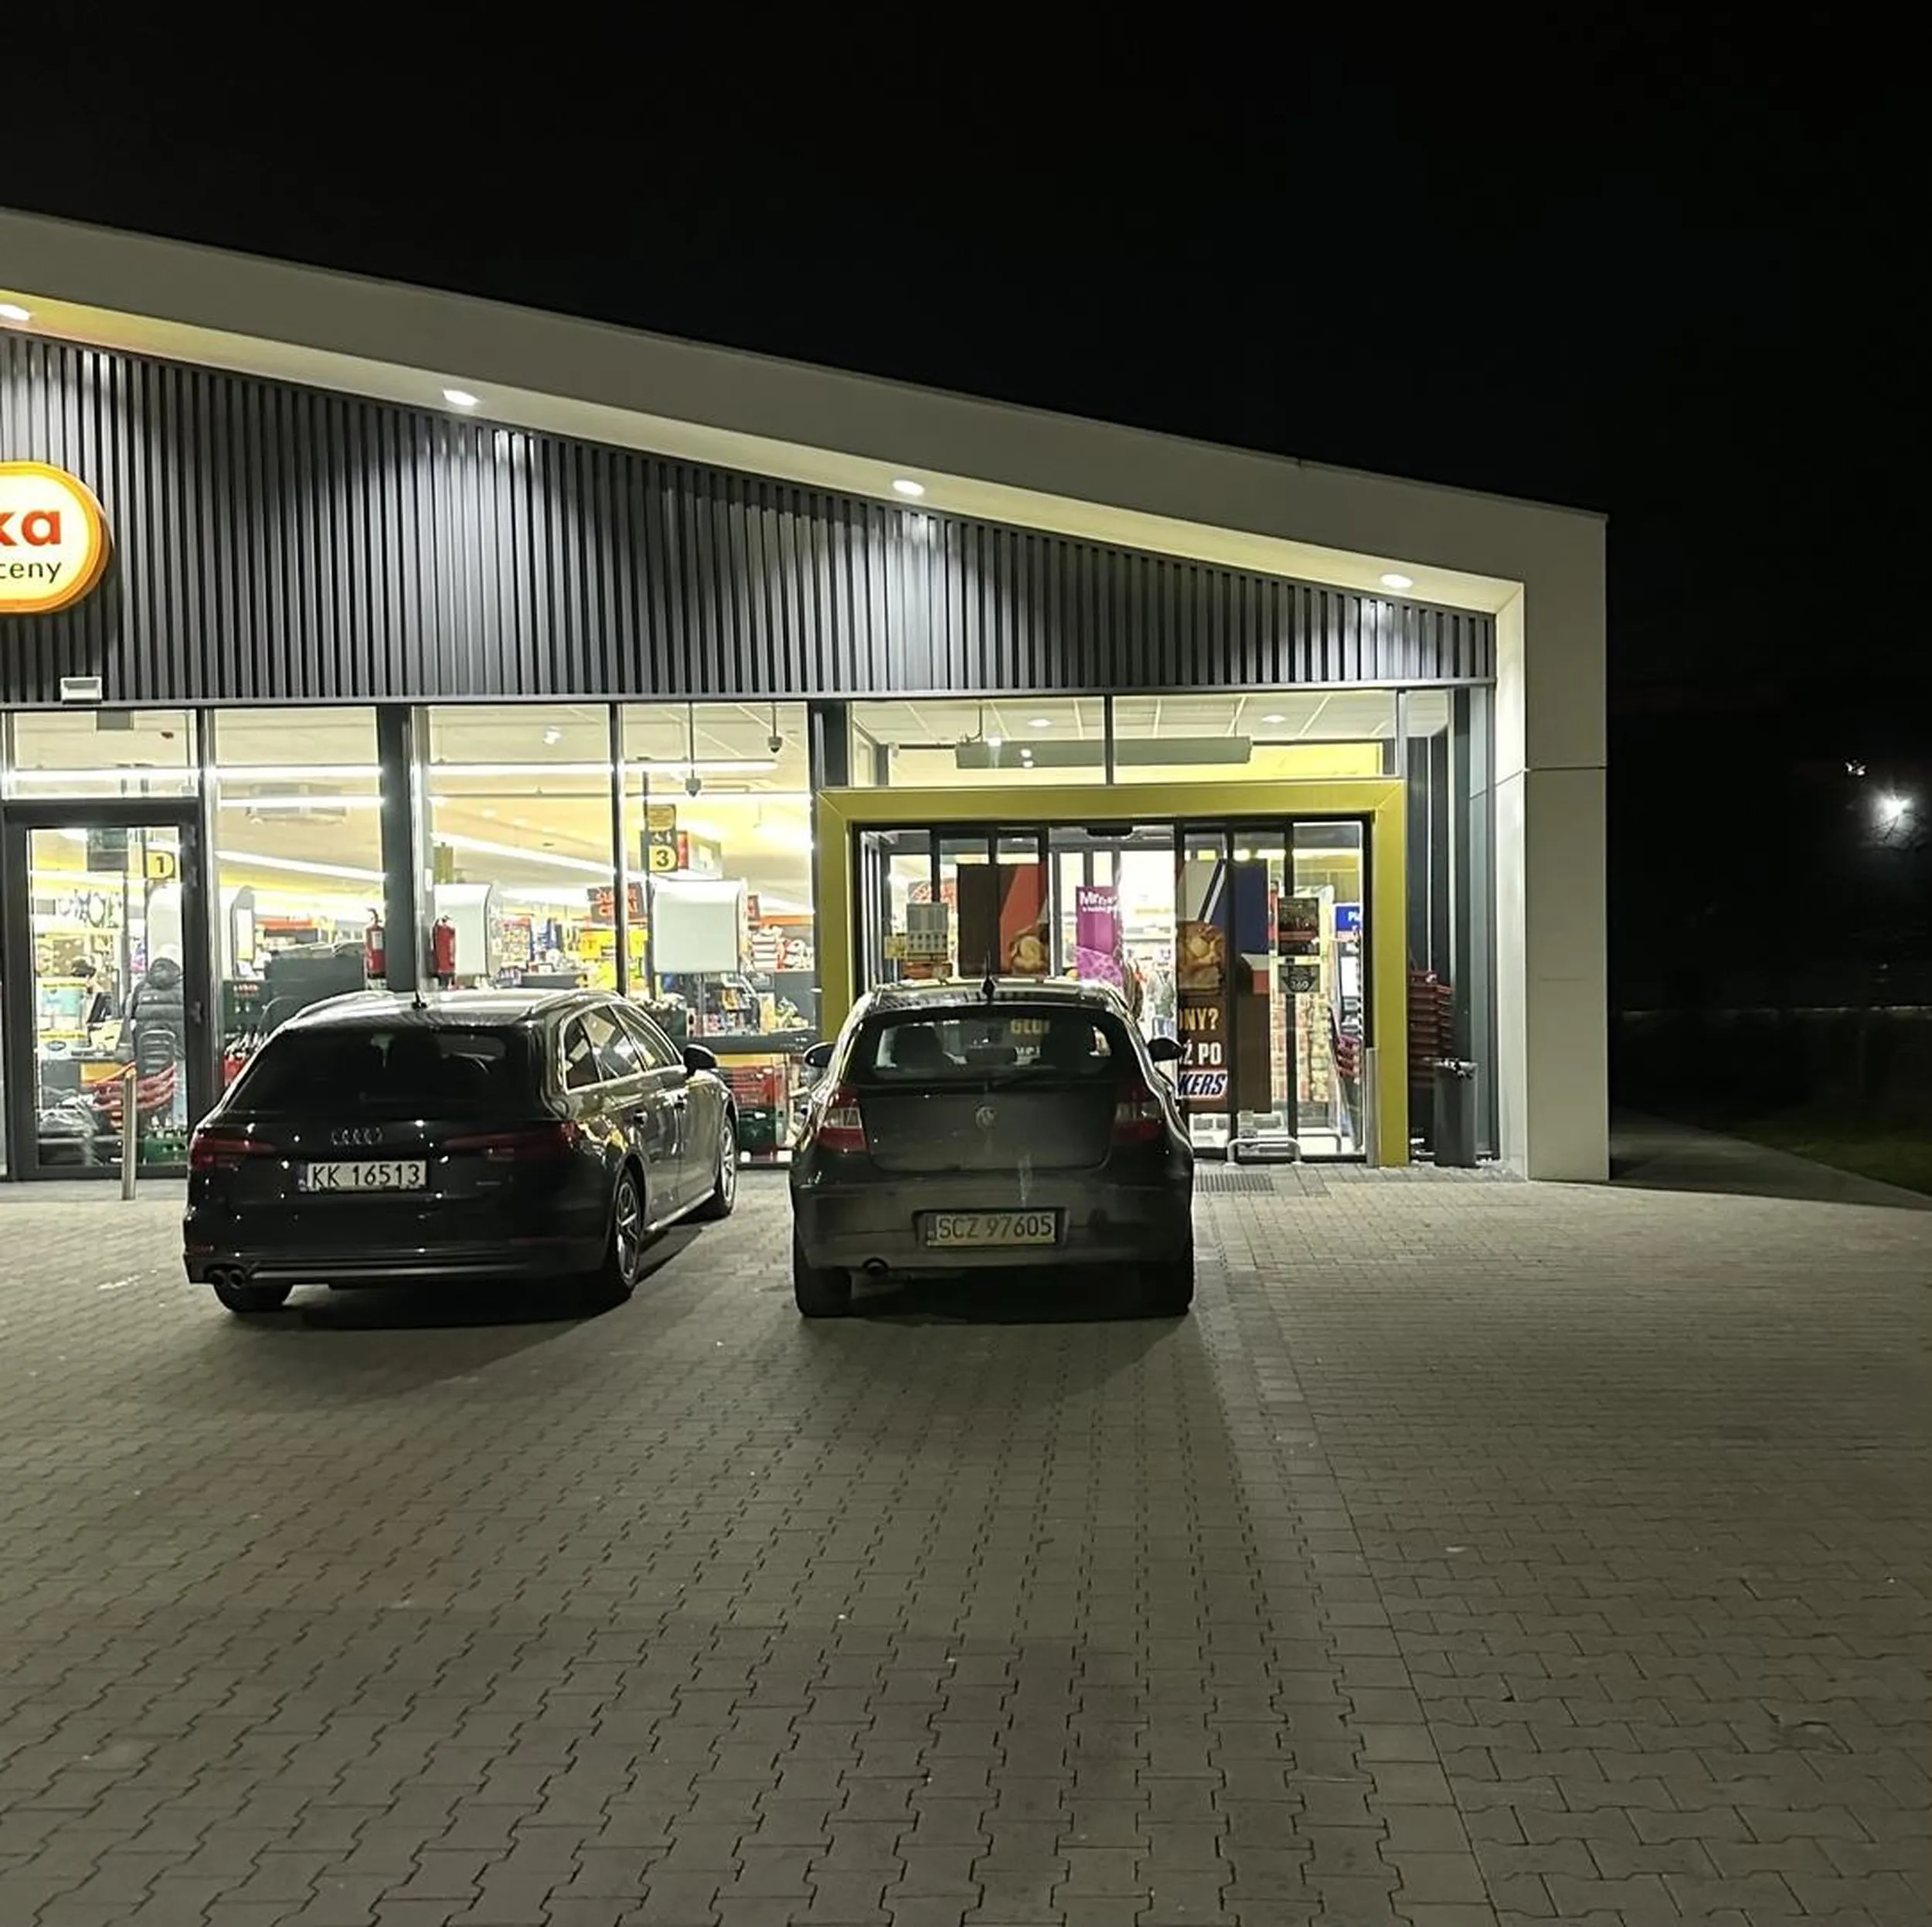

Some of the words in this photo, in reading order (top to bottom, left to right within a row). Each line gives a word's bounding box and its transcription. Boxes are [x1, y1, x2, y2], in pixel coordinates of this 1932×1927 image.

[156, 856, 164, 873] 1
[656, 849, 669, 867] 3
[1199, 1043, 1221, 1065] PO
[312, 1165, 341, 1188] KK
[352, 1163, 420, 1186] 16513
[937, 1217, 979, 1238] SCZ
[987, 1215, 1052, 1238] 97605
